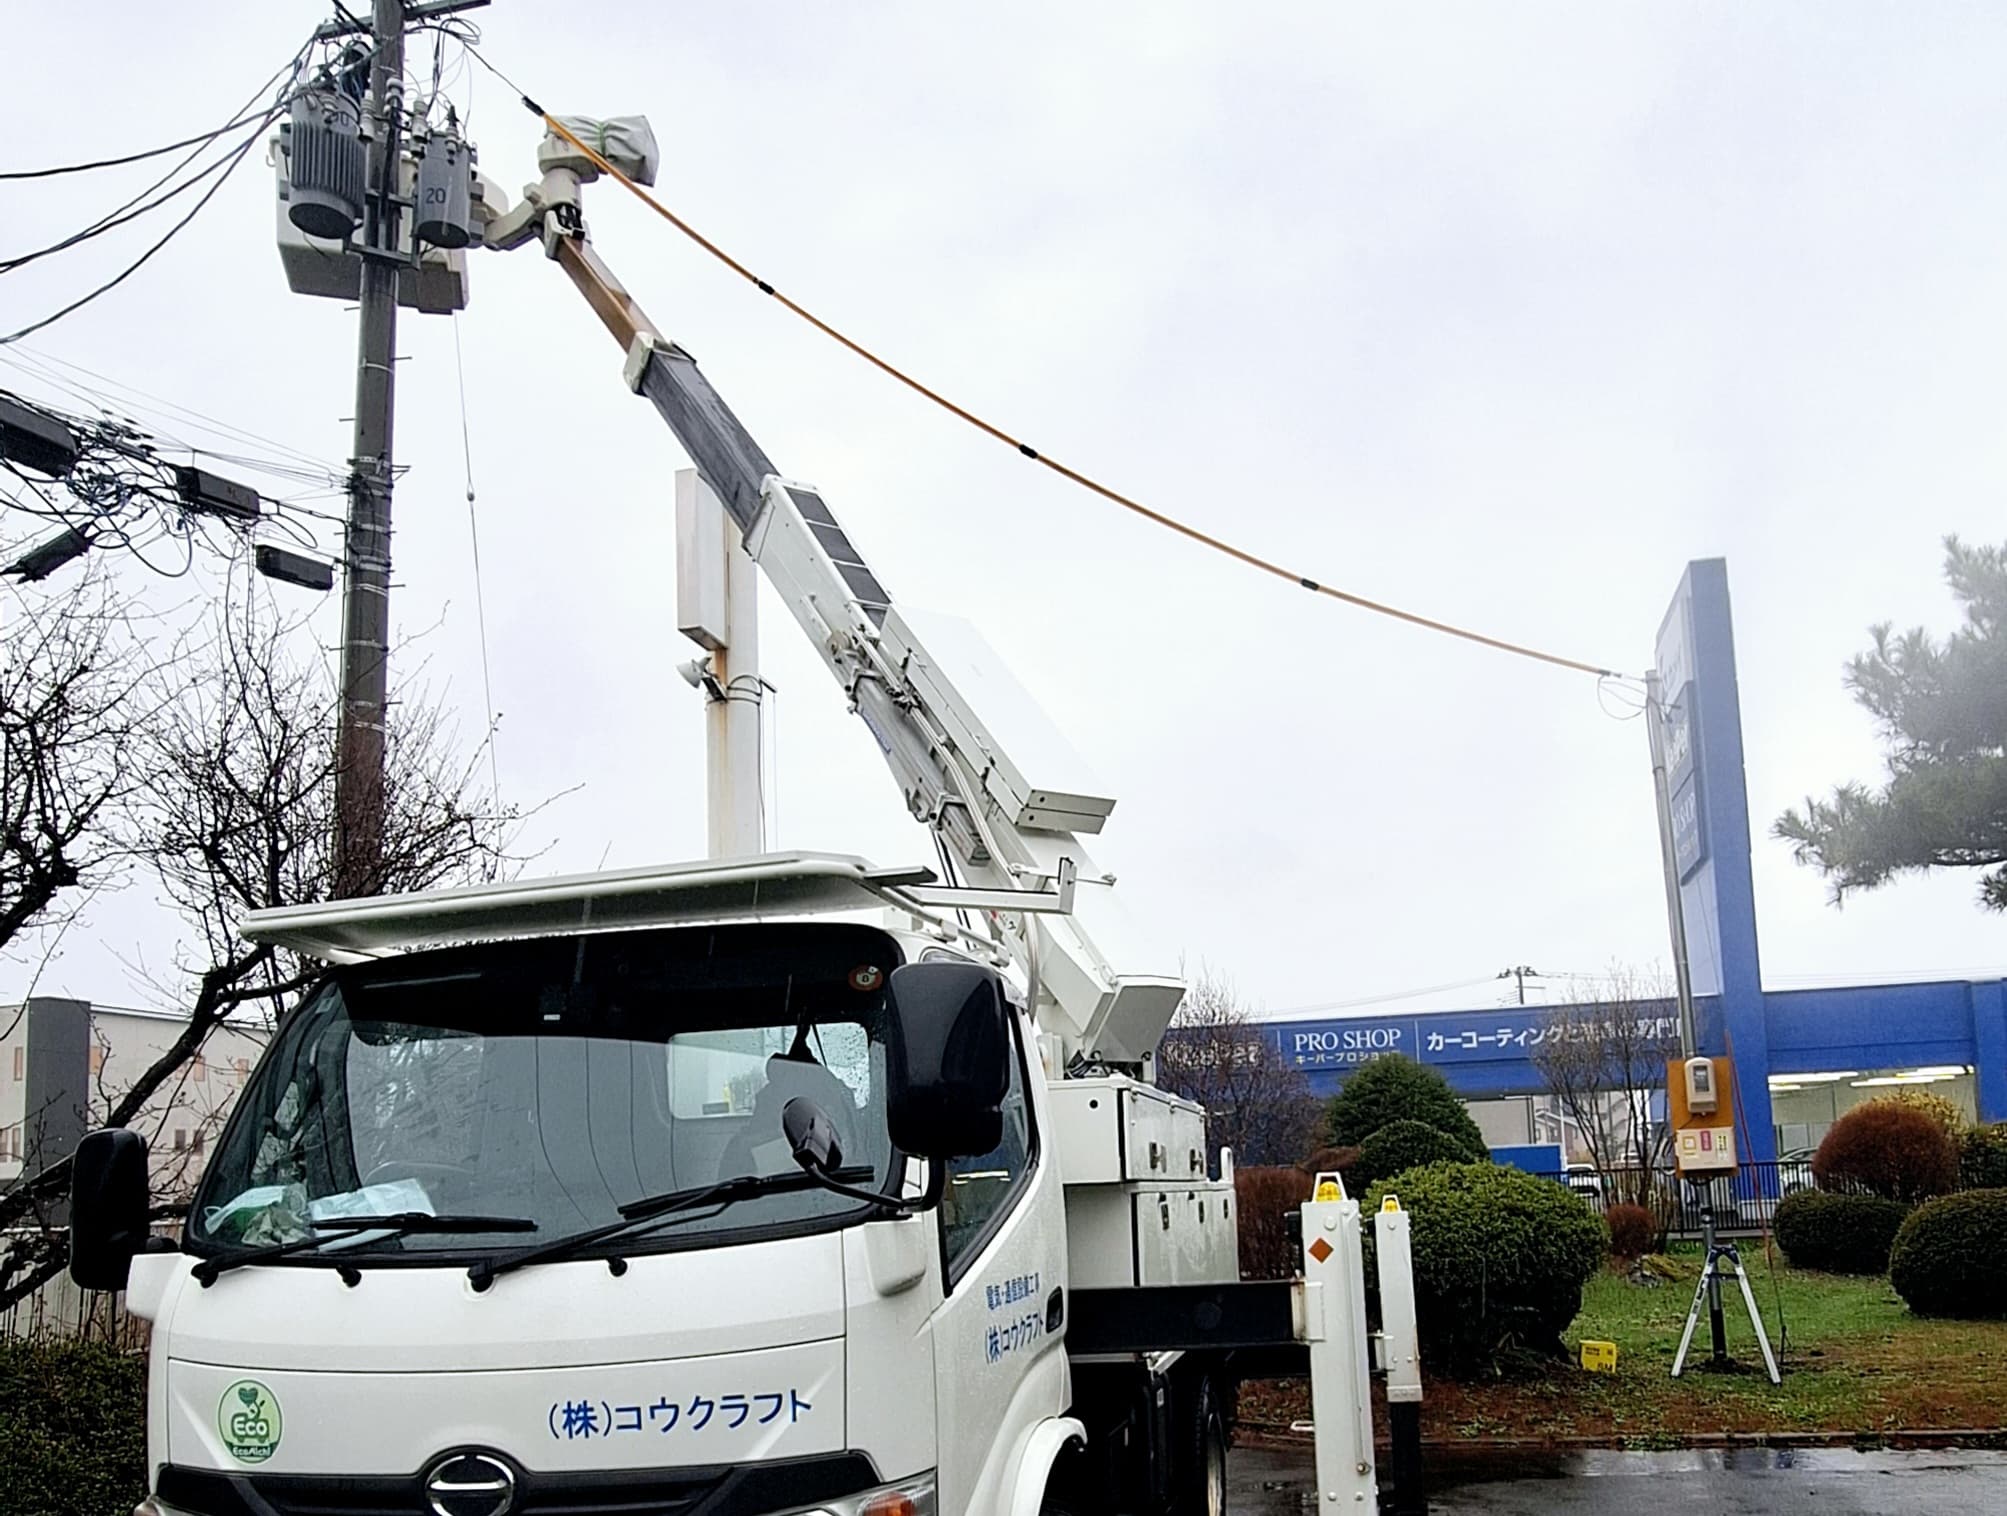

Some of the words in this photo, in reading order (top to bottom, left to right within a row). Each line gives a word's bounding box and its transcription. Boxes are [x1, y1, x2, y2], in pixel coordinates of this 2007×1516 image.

[425, 187, 447, 204] 20
[1294, 1031, 1340, 1052] PRO
[1343, 1028, 1401, 1049] SHOP
[549, 1389, 812, 1440] (株)コウクラフト
